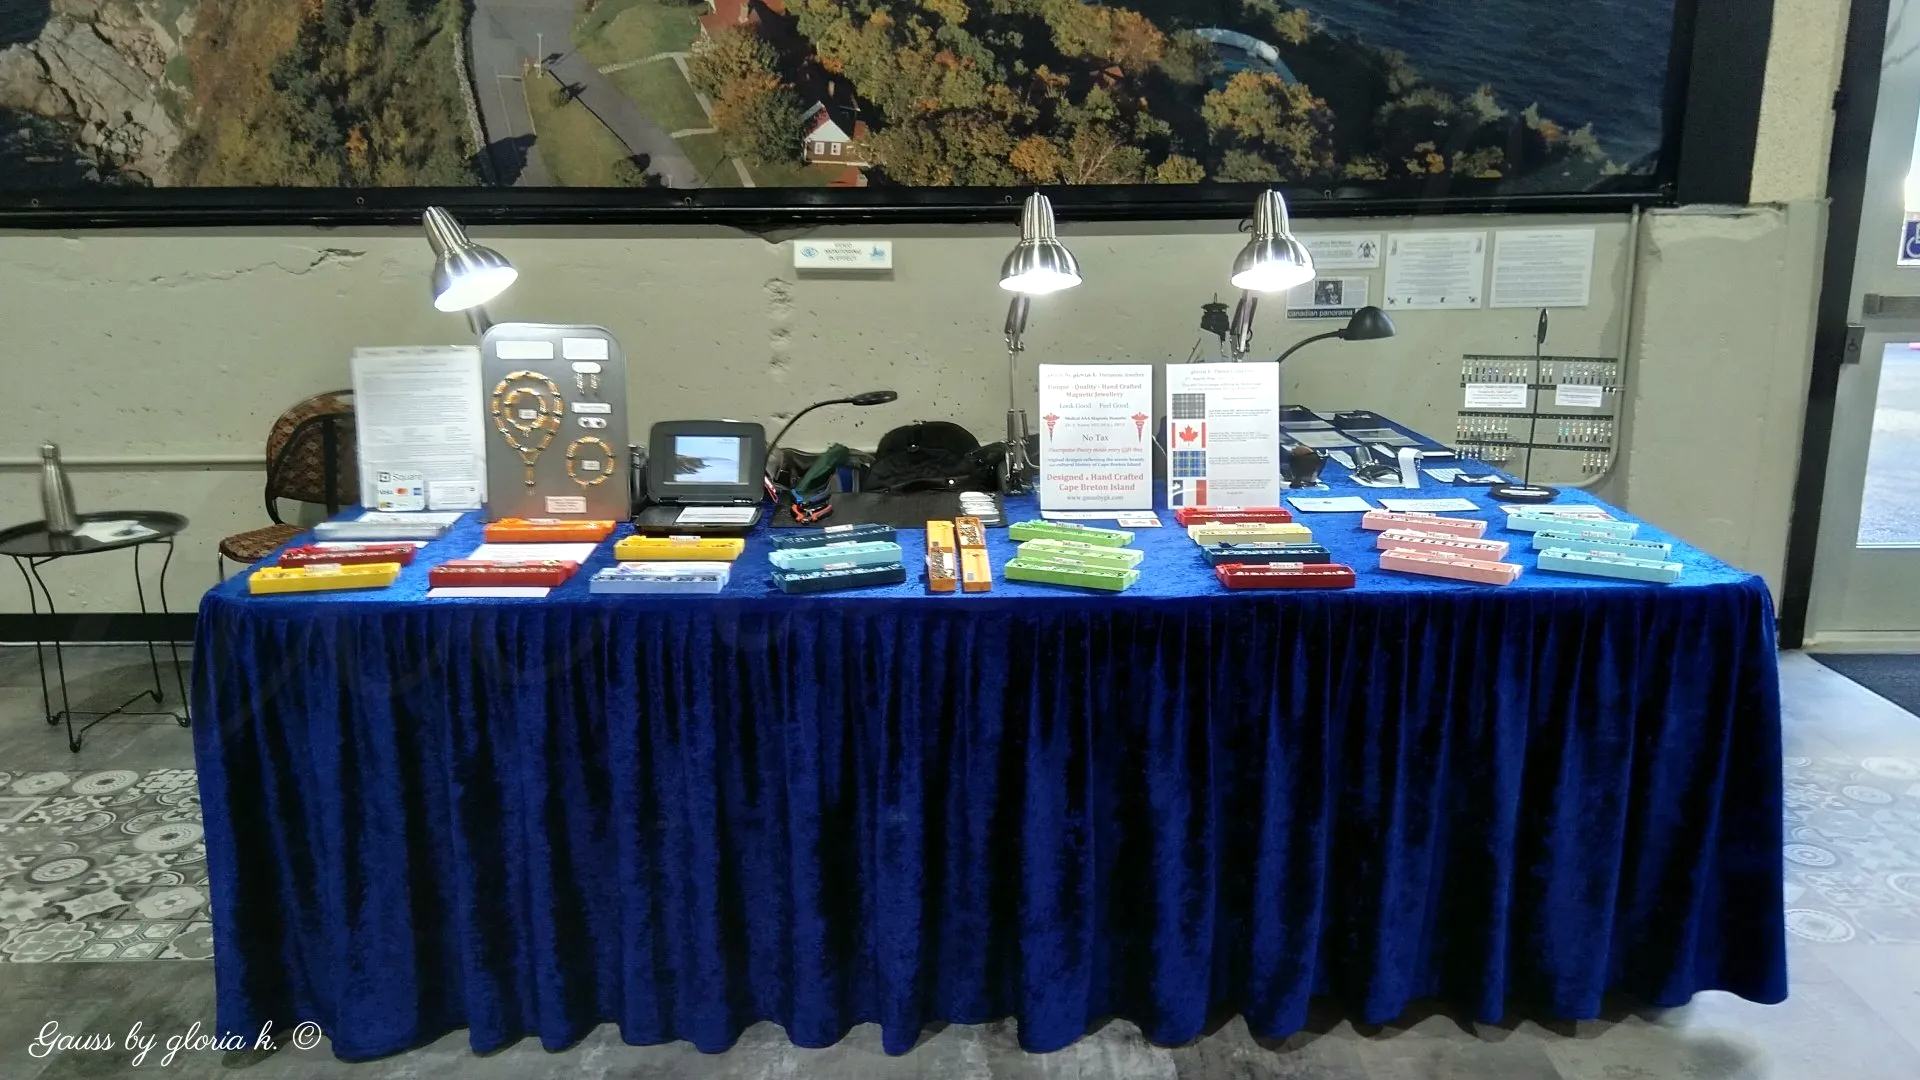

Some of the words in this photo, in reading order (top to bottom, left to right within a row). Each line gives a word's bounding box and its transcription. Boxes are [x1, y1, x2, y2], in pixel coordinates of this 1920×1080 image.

[1287, 309, 1318, 318] canadian
[1319, 309, 1353, 318] panorama
[1095, 391, 1124, 399] Jewellery
[1082, 434, 1094, 442] No
[1096, 434, 1109, 442] Tax
[1046, 473, 1084, 482] Designed
[1090, 473, 1112, 481] Hand
[1114, 473, 1144, 481] Crafted
[1058, 483, 1079, 492] Cape
[1080, 483, 1109, 491] Breton
[1110, 483, 1136, 491] Island
